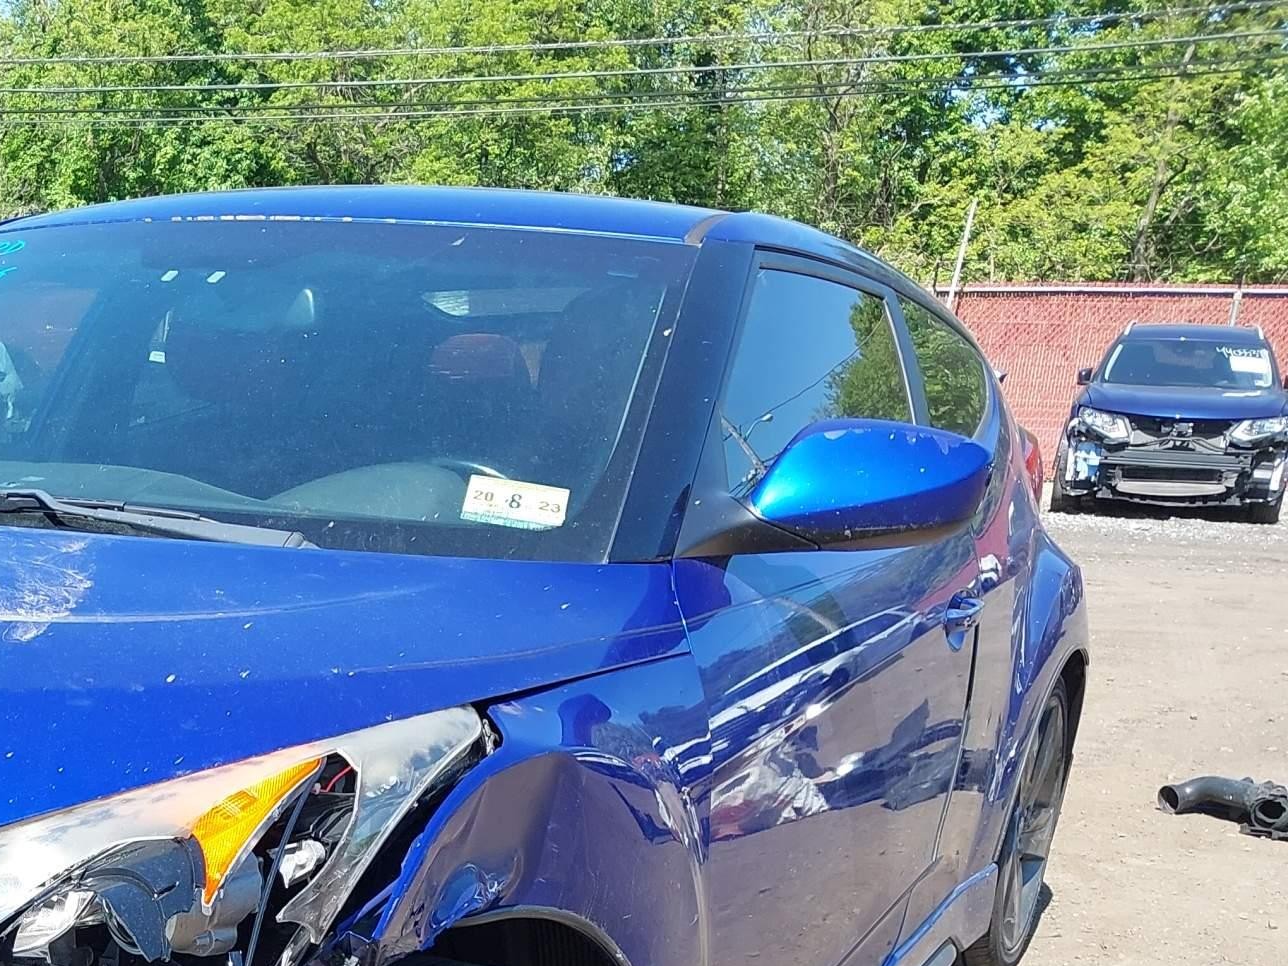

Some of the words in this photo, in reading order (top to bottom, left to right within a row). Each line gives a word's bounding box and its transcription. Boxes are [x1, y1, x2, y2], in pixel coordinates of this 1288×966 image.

[472, 489, 495, 502] 20
[508, 493, 523, 509] 8
[538, 500, 561, 513] 23
